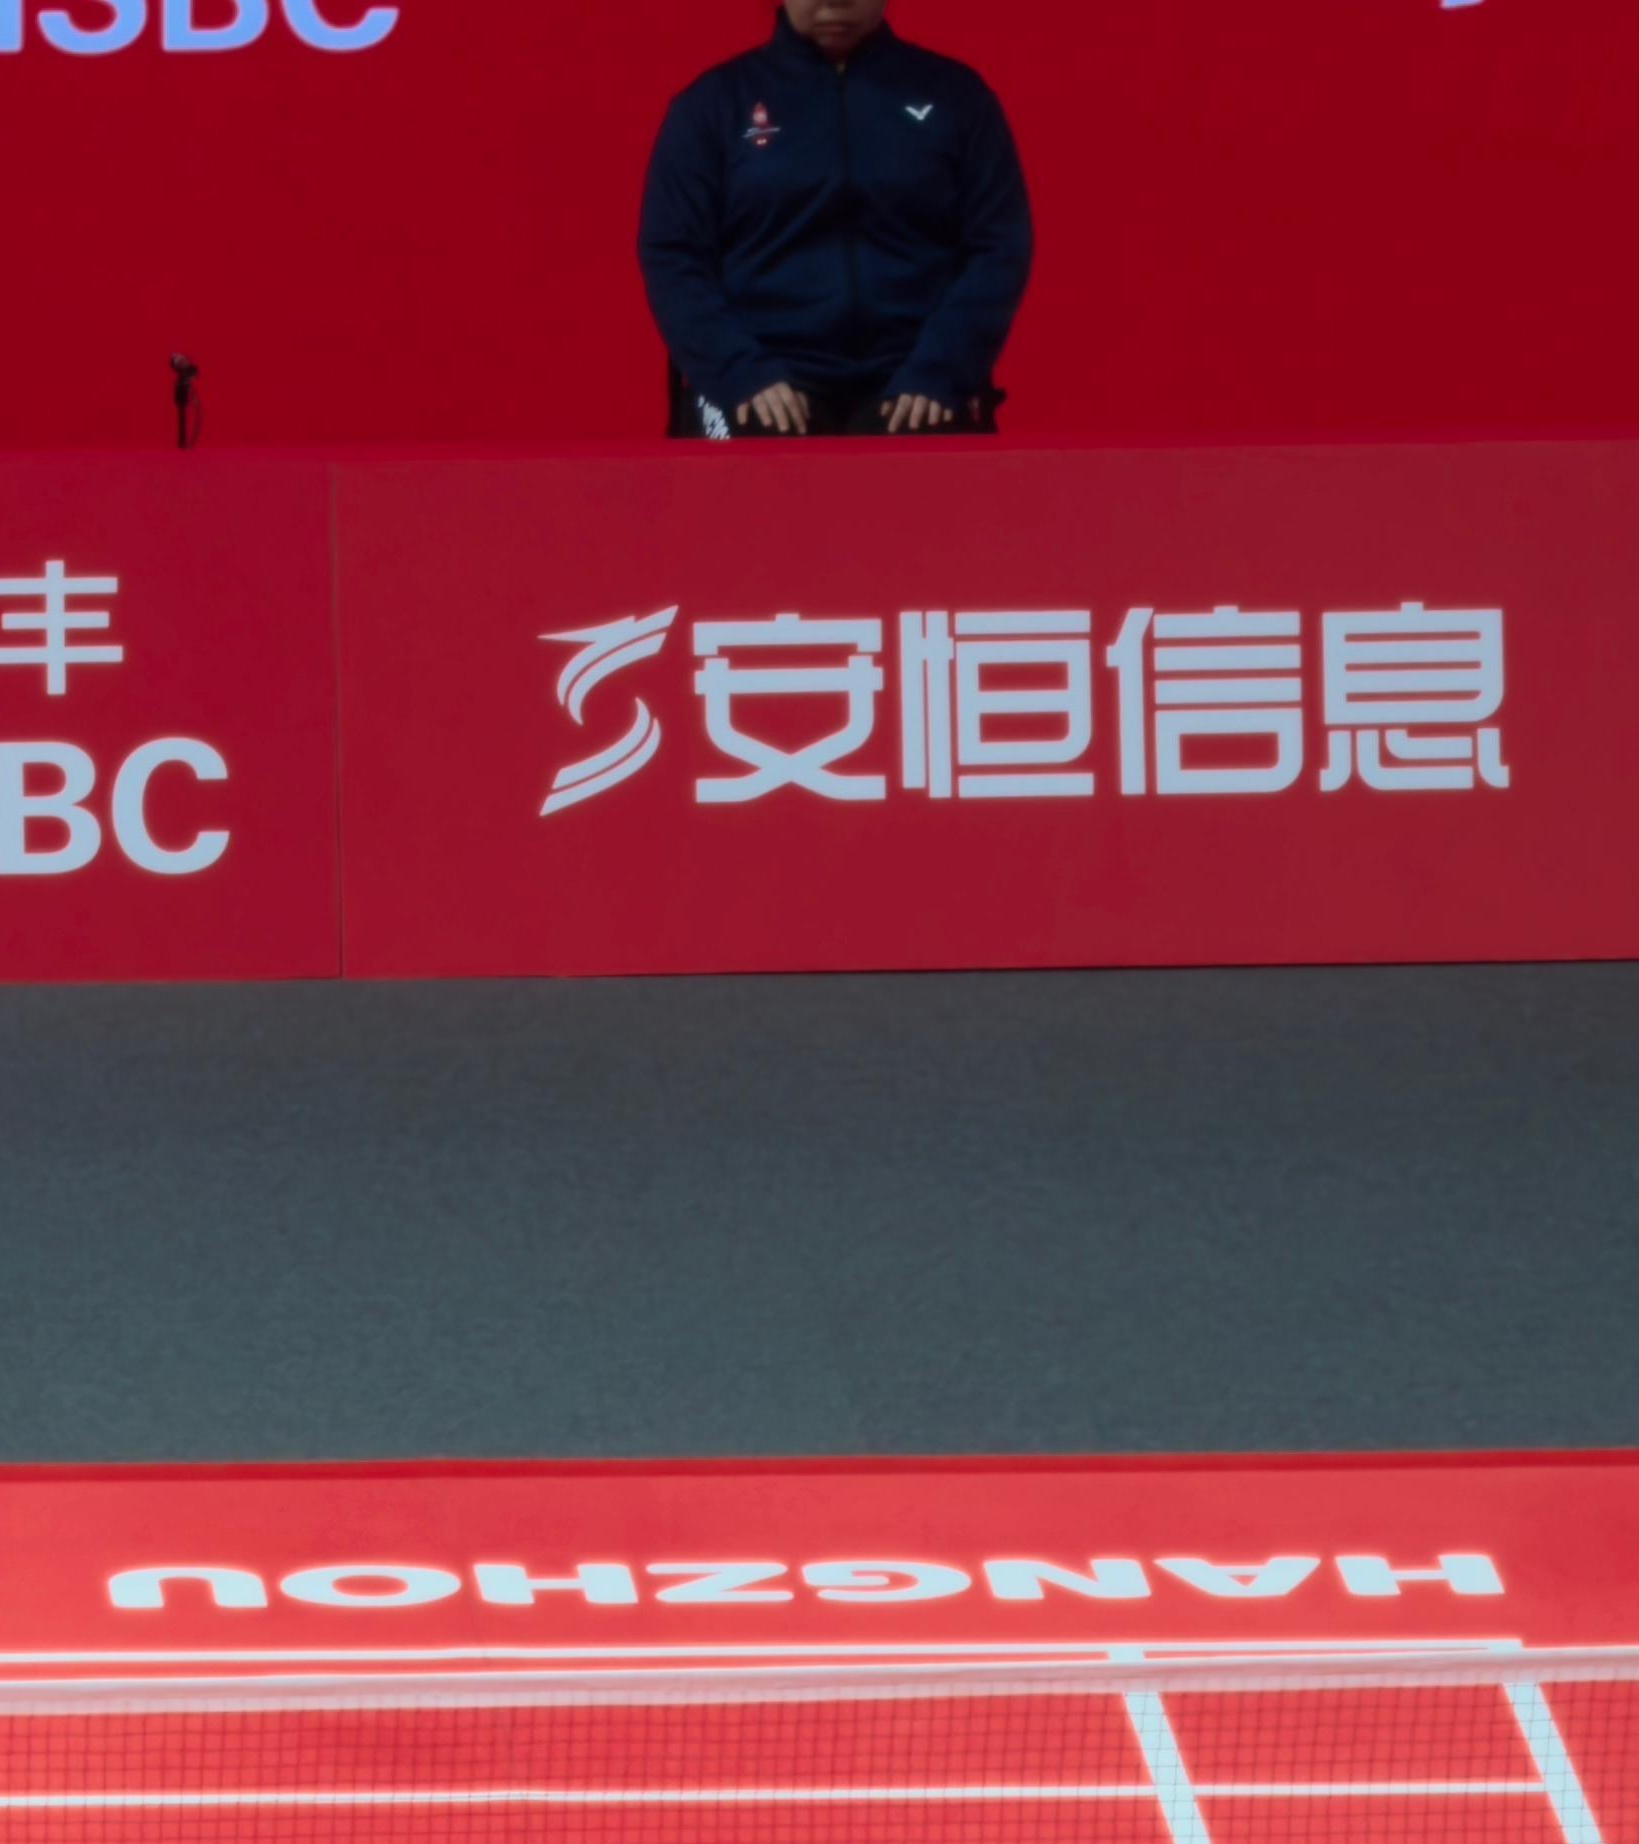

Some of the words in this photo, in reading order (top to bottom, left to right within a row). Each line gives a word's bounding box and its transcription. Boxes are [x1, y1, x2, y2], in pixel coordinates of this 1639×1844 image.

[692, 601, 1510, 804] 安恒信息
[106, 1552, 1505, 1611] HANGZHOU
